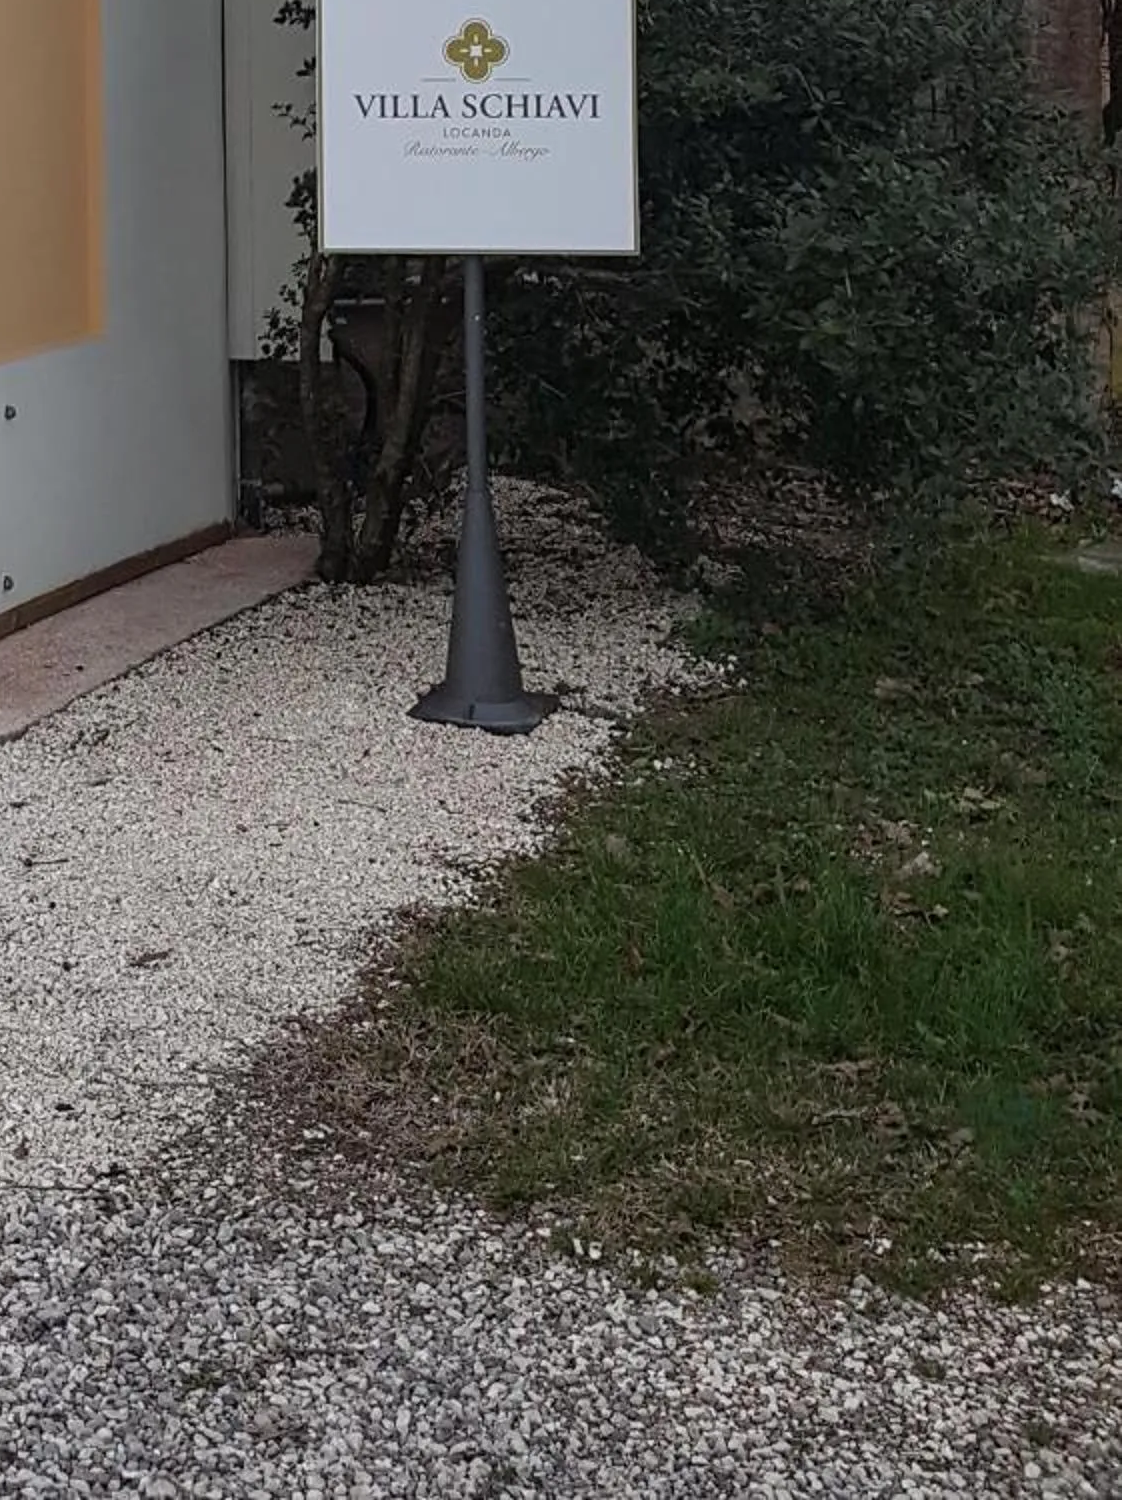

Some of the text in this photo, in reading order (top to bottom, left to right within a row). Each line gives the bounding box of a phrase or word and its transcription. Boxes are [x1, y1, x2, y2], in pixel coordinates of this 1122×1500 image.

[354, 93, 601, 118] VILLA SCHIAVI
[443, 127, 512, 138] LOCANDA
